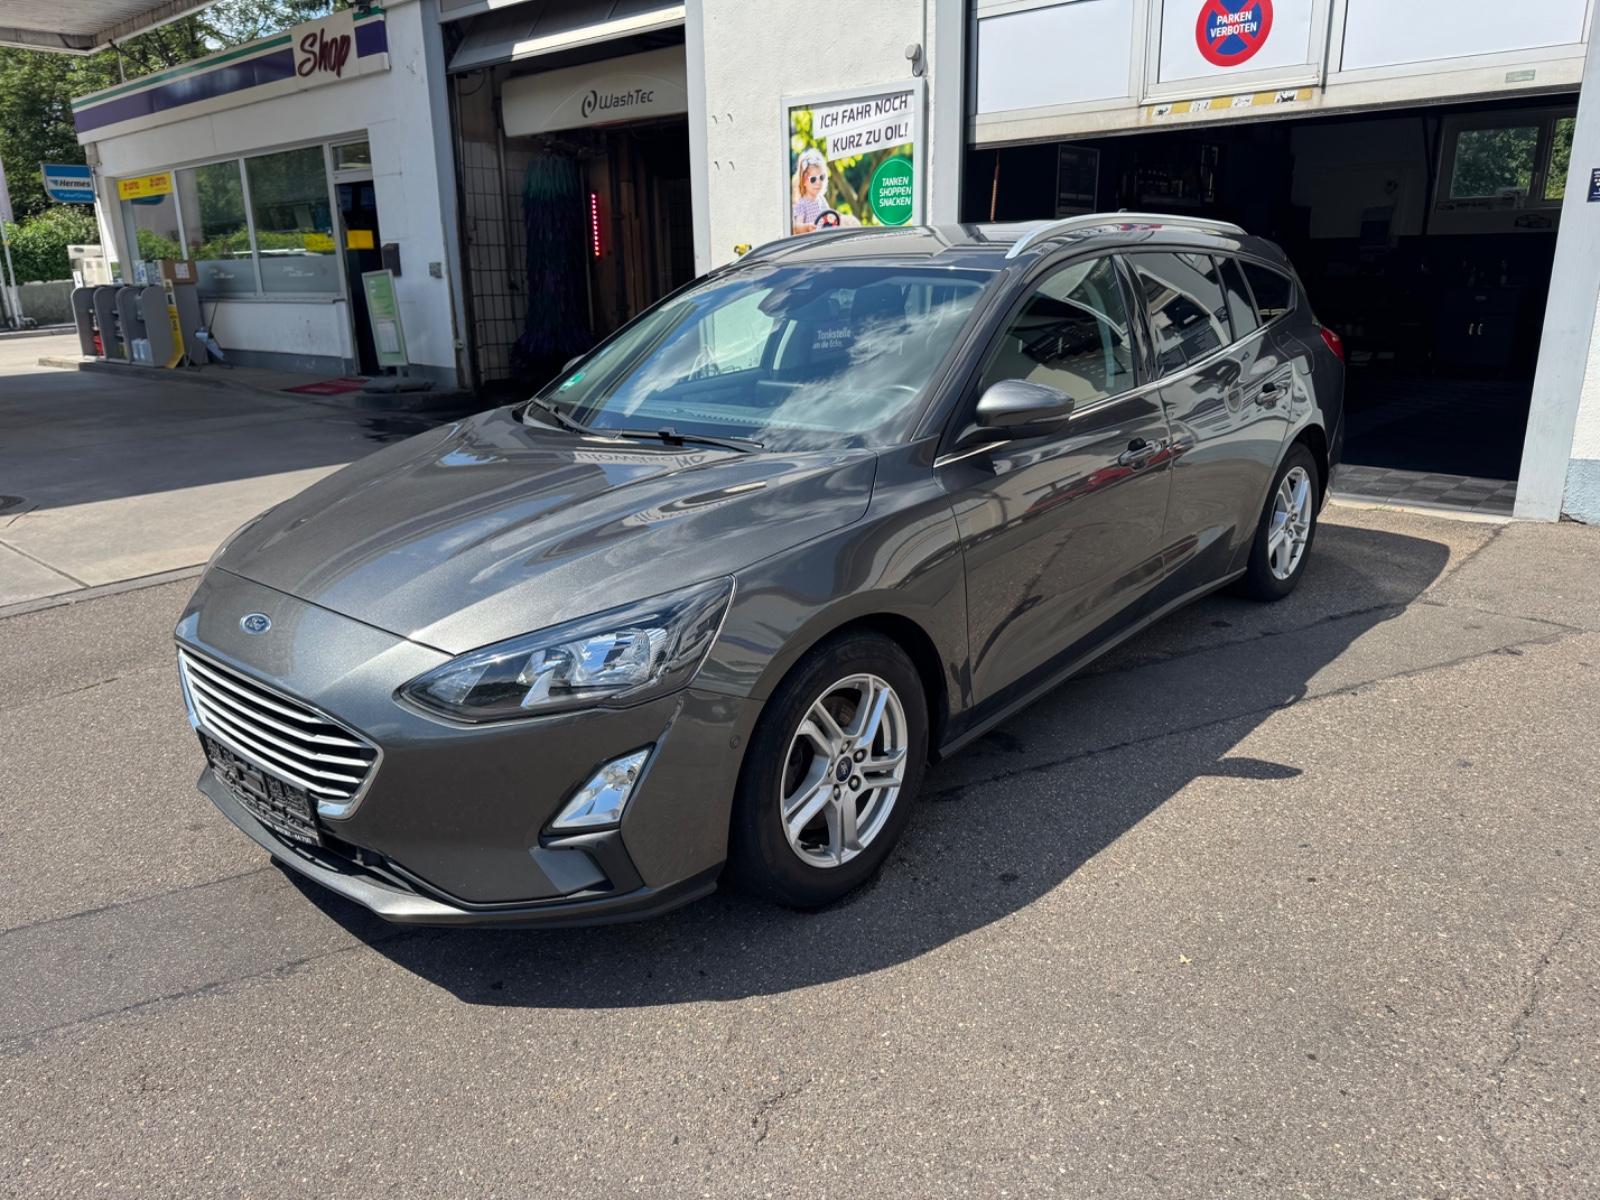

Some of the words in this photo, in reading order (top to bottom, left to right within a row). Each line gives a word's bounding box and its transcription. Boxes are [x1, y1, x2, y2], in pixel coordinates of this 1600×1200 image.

[1216, 10, 1252, 26] PARKEN
[1210, 21, 1257, 38] VERBOTEN
[298, 27, 351, 78] Shop
[820, 111, 839, 129] ICH
[841, 103, 872, 124] FAHR
[874, 94, 909, 115] NOCH
[832, 133, 863, 153] KURZ
[865, 128, 882, 145] ZU
[884, 122, 909, 141] OIL!
[59, 179, 92, 188] Hermes
[882, 176, 910, 187] TANKEN
[879, 186, 912, 197] SHOPPEN
[879, 196, 912, 207] SNACKEN
